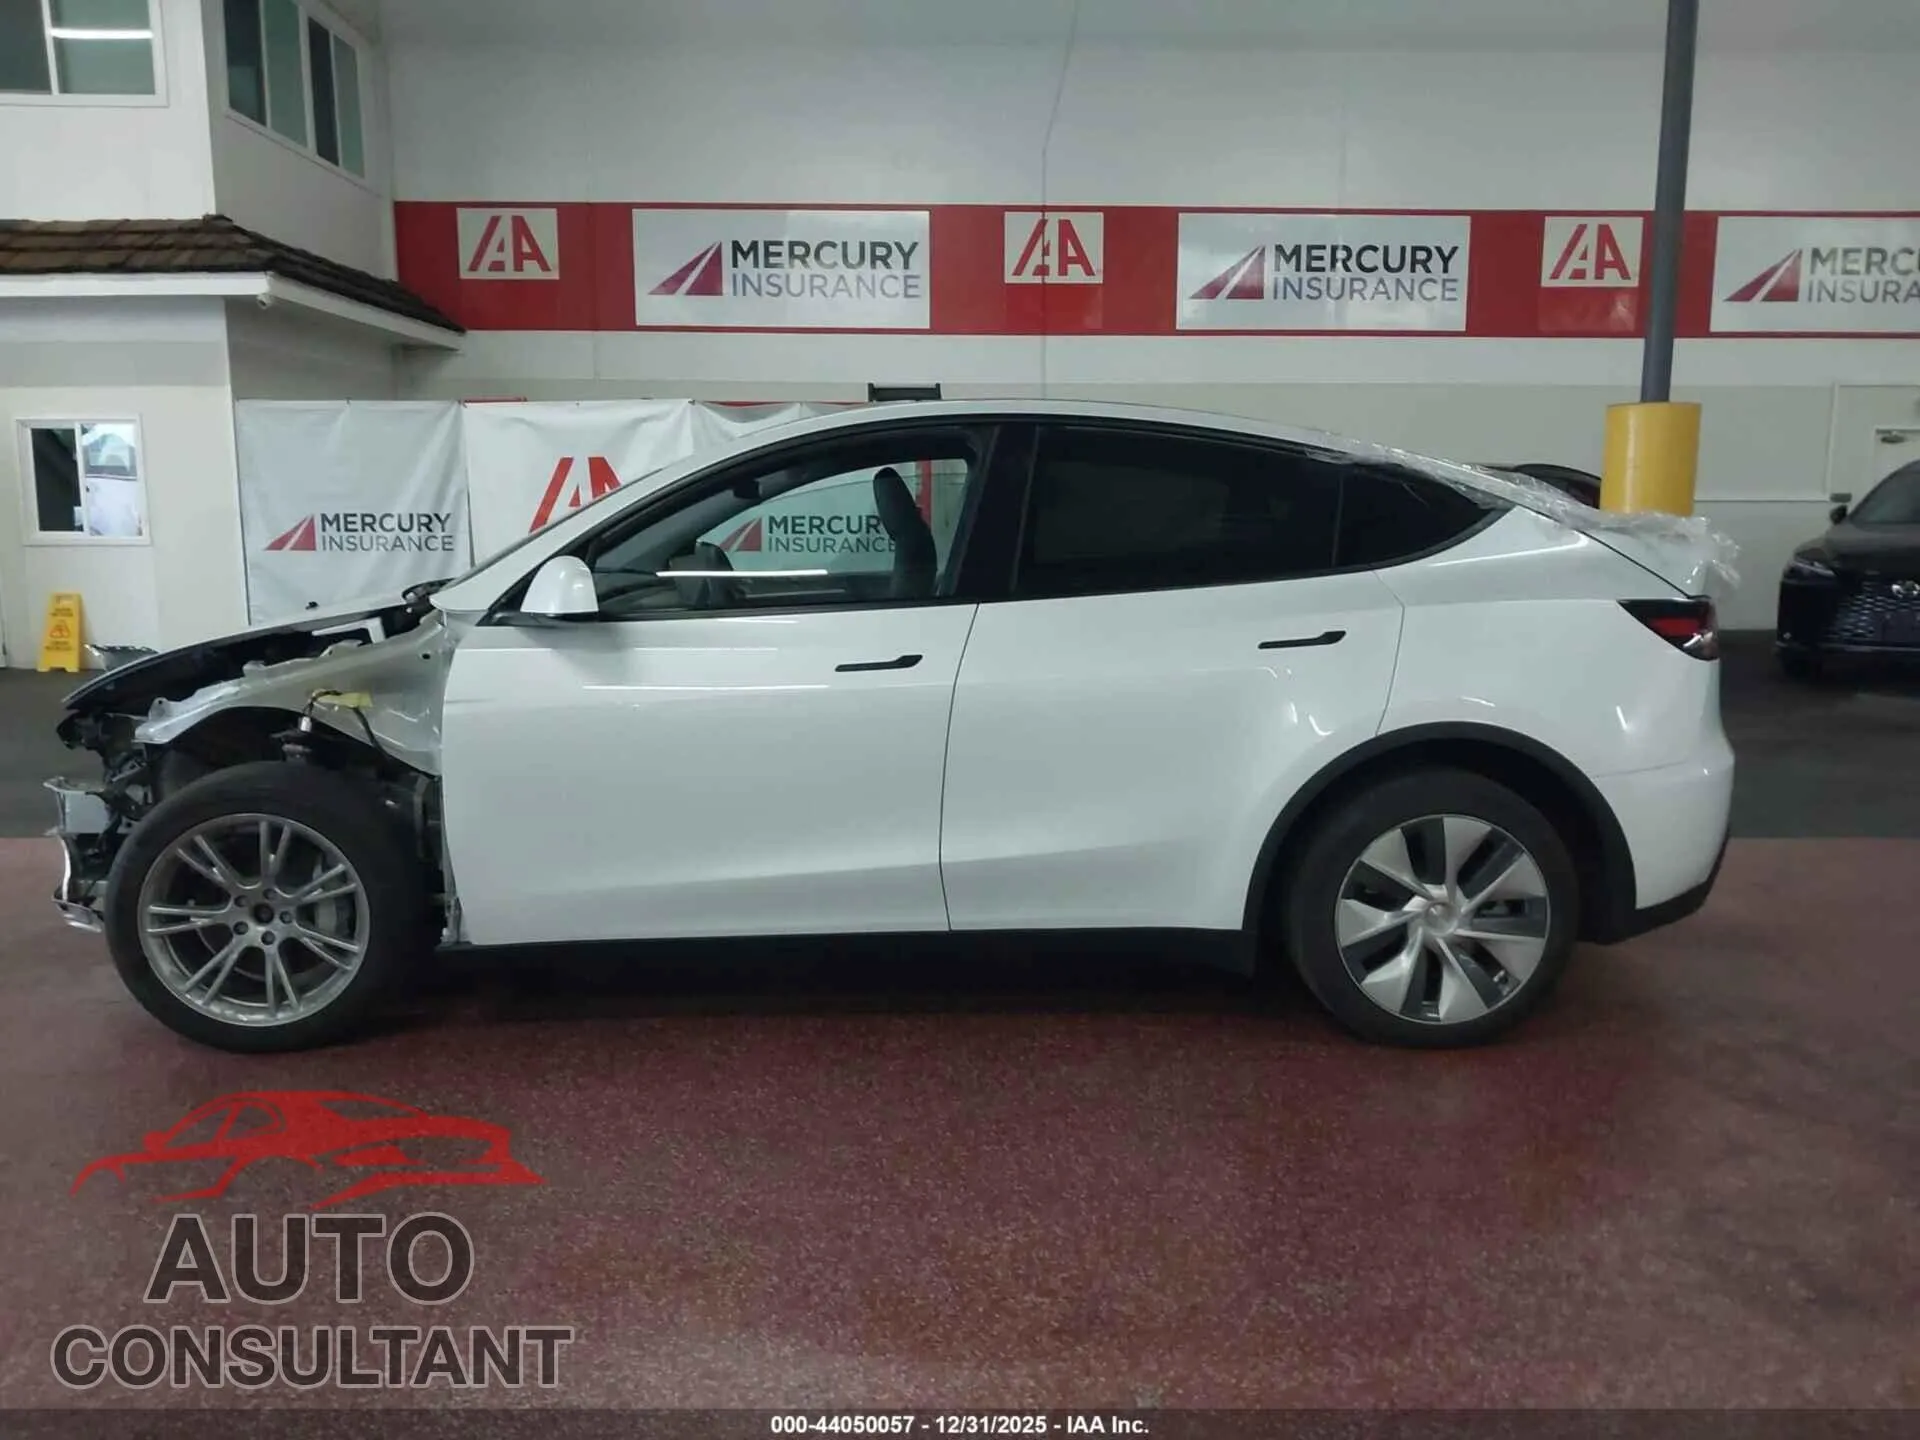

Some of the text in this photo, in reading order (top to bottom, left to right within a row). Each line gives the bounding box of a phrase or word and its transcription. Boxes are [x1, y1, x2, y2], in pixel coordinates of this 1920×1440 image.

[731, 239, 919, 270] MERCURY
[1274, 244, 1459, 273] MERCURY
[1810, 247, 1920, 276] MERC
[732, 273, 921, 298] INSURANCE
[1273, 276, 1458, 301] INSURANCE
[320, 512, 452, 533] MERCURY
[768, 515, 882, 535] MERCUR
[321, 535, 454, 552] INSURANCE
